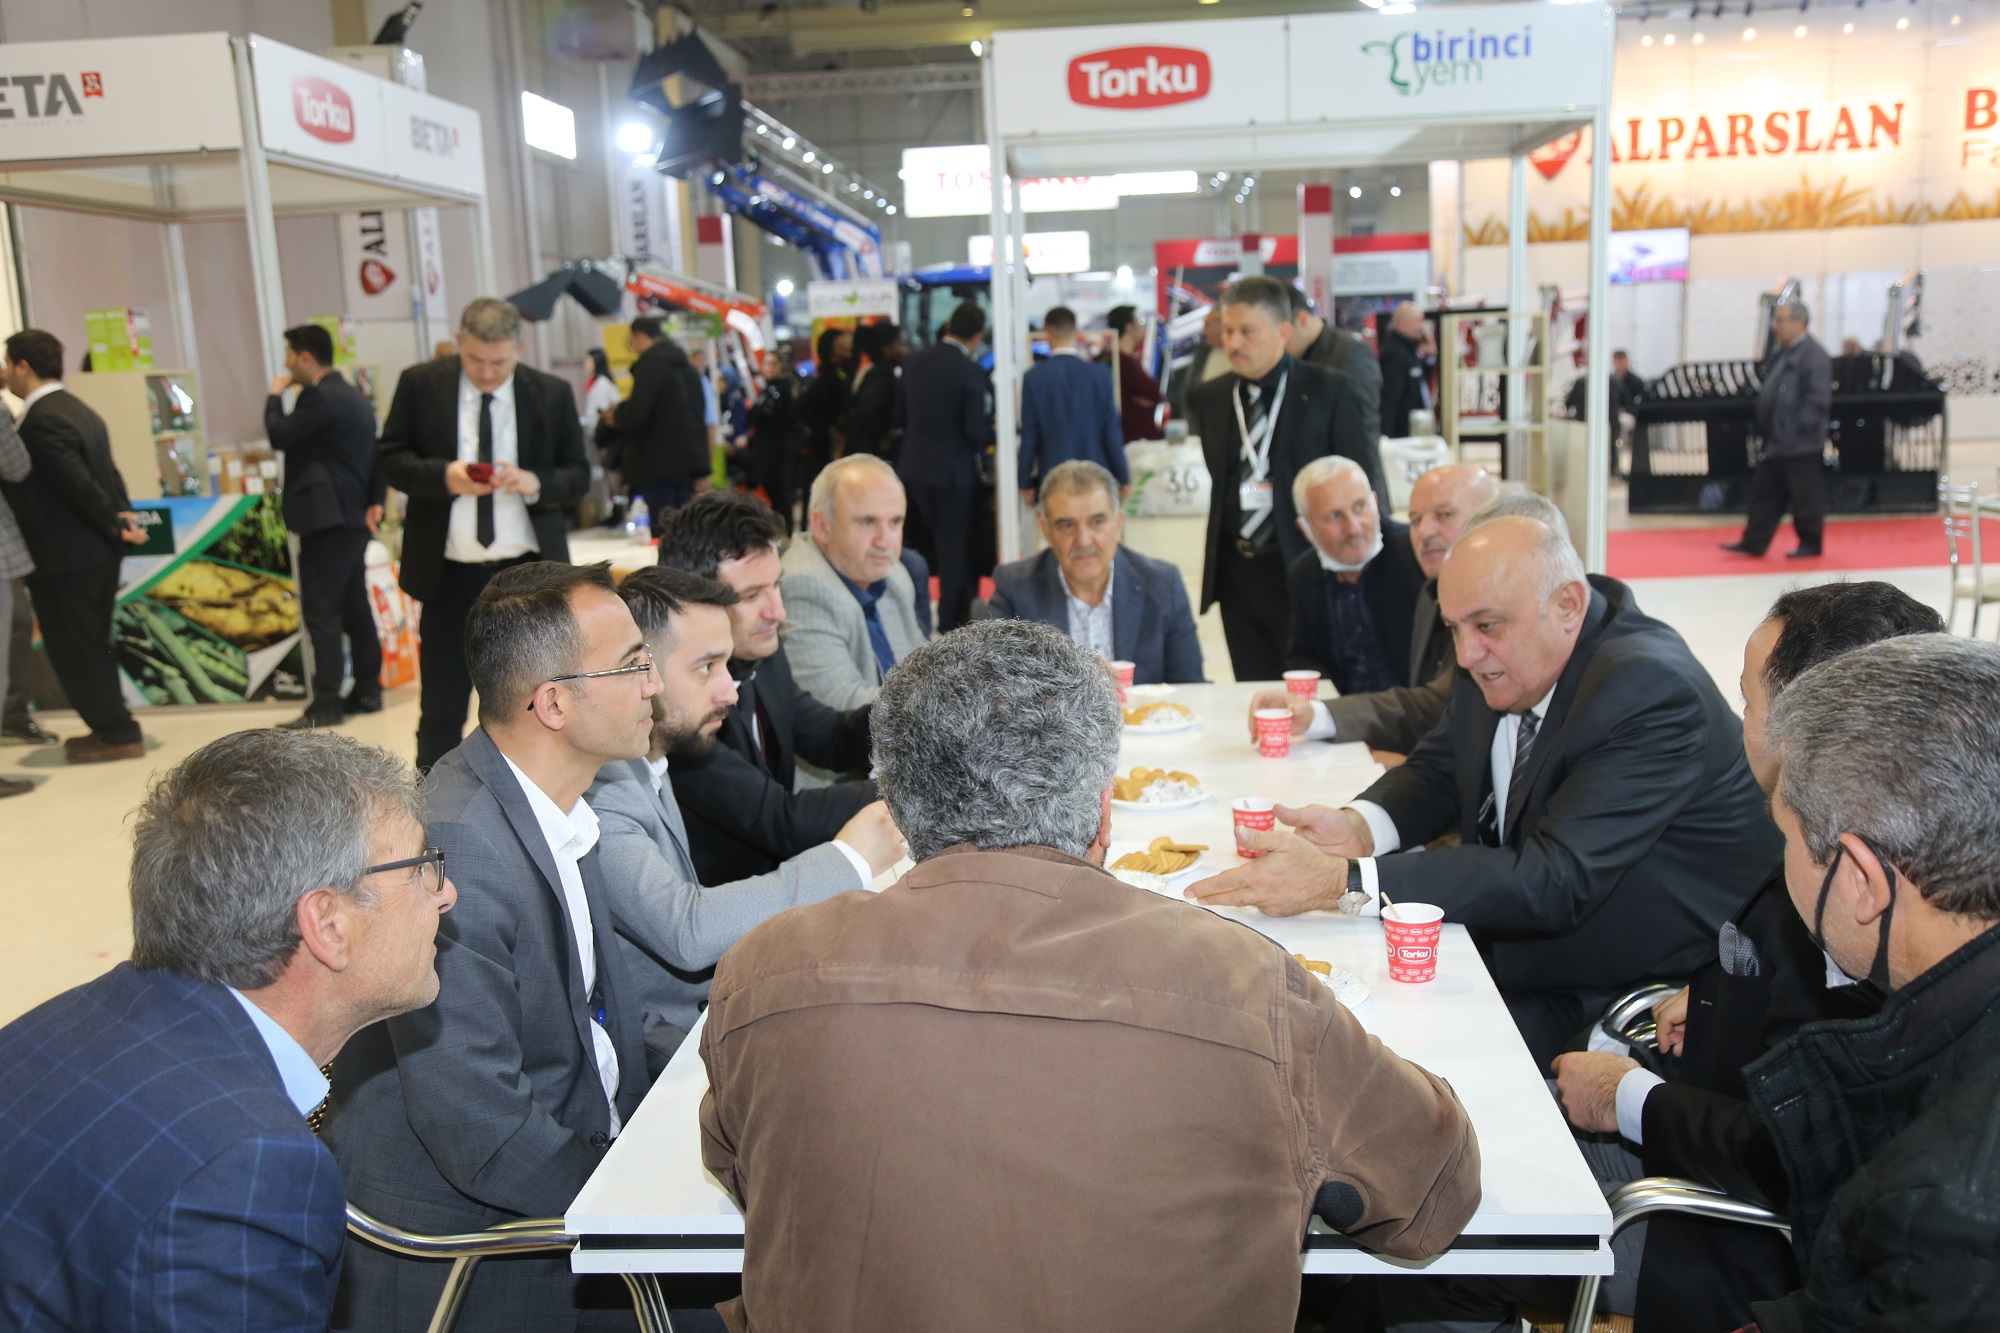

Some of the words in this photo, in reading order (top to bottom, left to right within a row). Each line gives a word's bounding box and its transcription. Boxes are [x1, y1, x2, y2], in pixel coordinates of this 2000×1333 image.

[1412, 24, 1533, 62] birinci
[1078, 56, 1198, 99] Torku
[1413, 60, 1484, 96] yem
[297, 87, 352, 134] Torku
[1401, 949, 1428, 959] Torku
